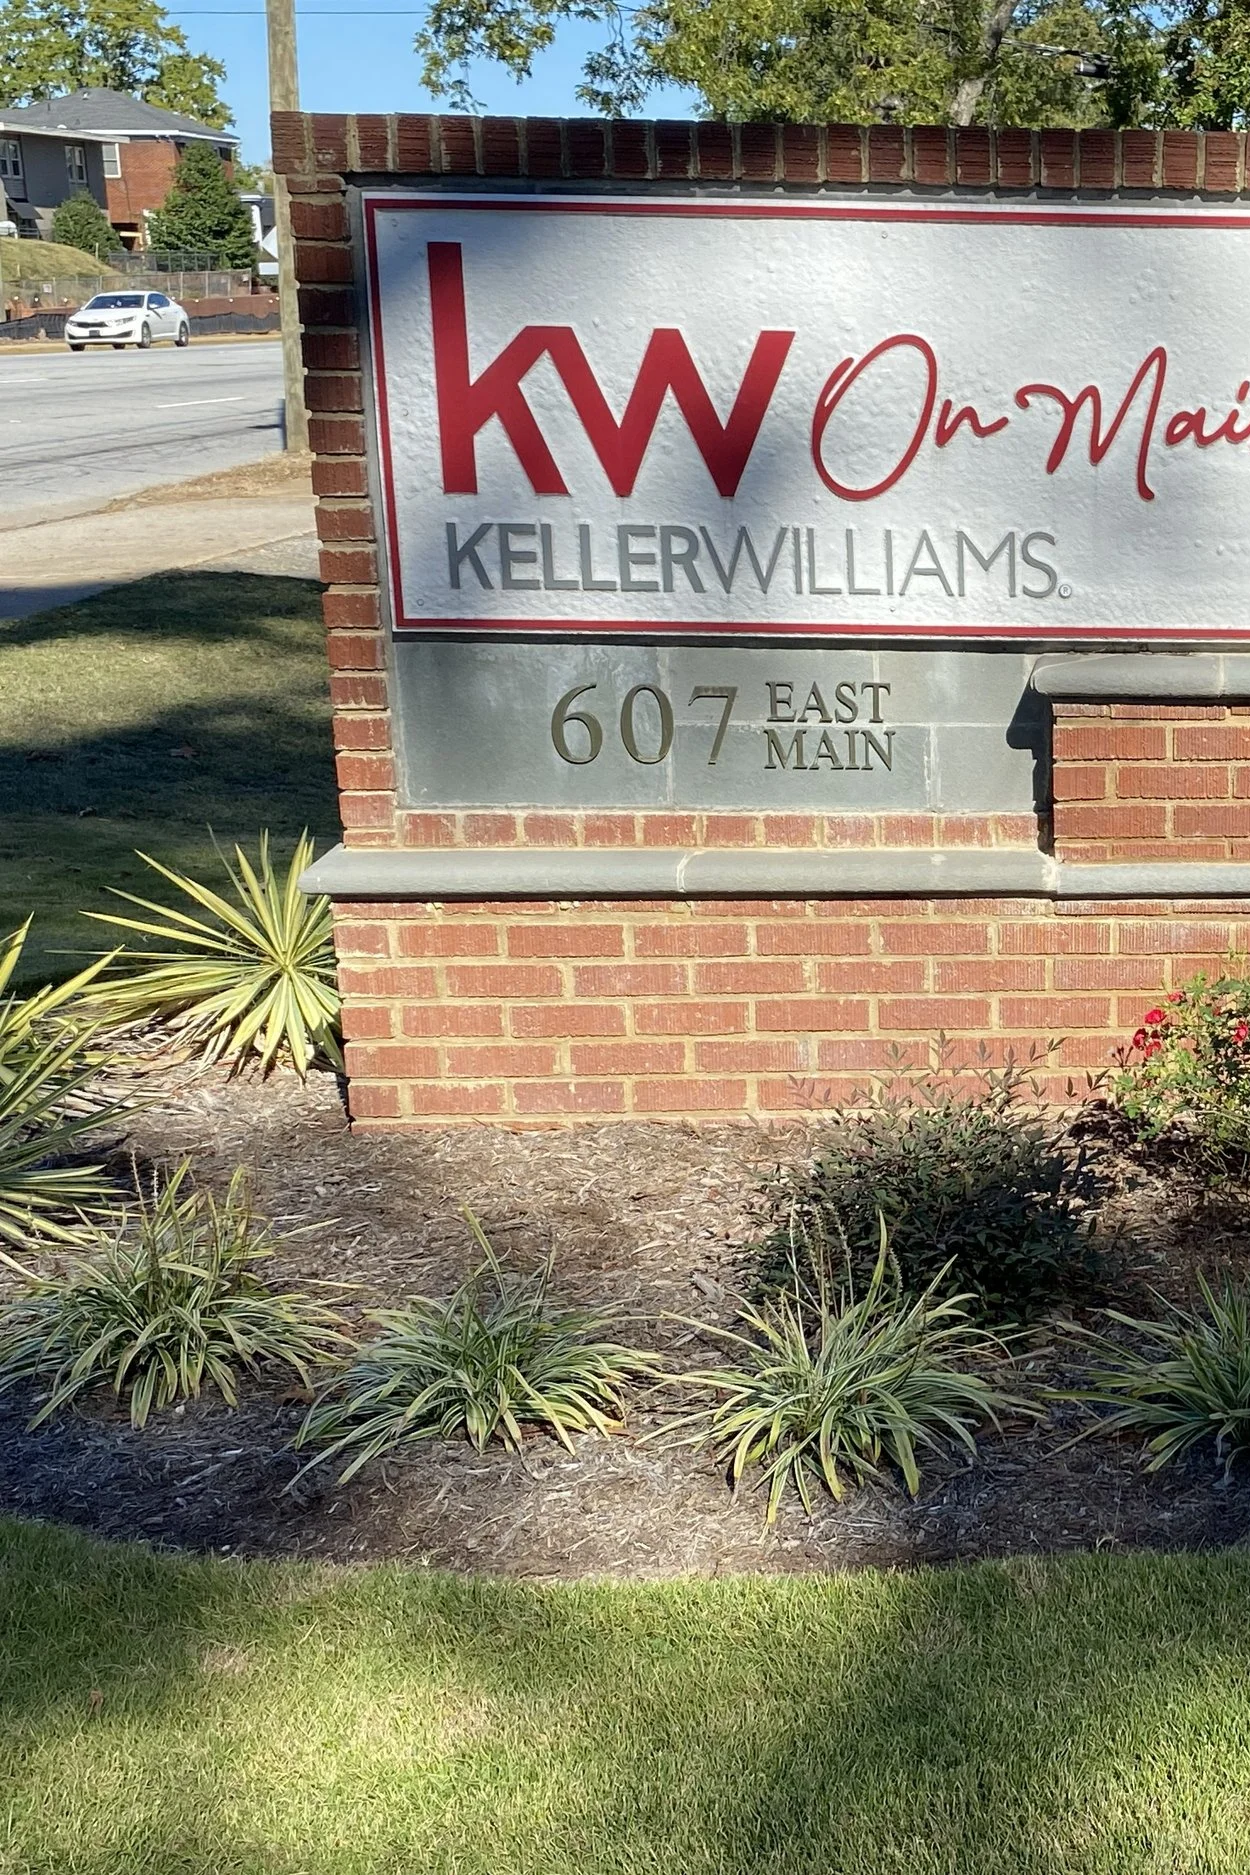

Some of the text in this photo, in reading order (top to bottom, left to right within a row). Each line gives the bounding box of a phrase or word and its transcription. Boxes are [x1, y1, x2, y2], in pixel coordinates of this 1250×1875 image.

[812, 334, 1008, 502] On
[550, 683, 739, 765] 607
[766, 682, 891, 724] EAST
[765, 730, 896, 772] MAIN
